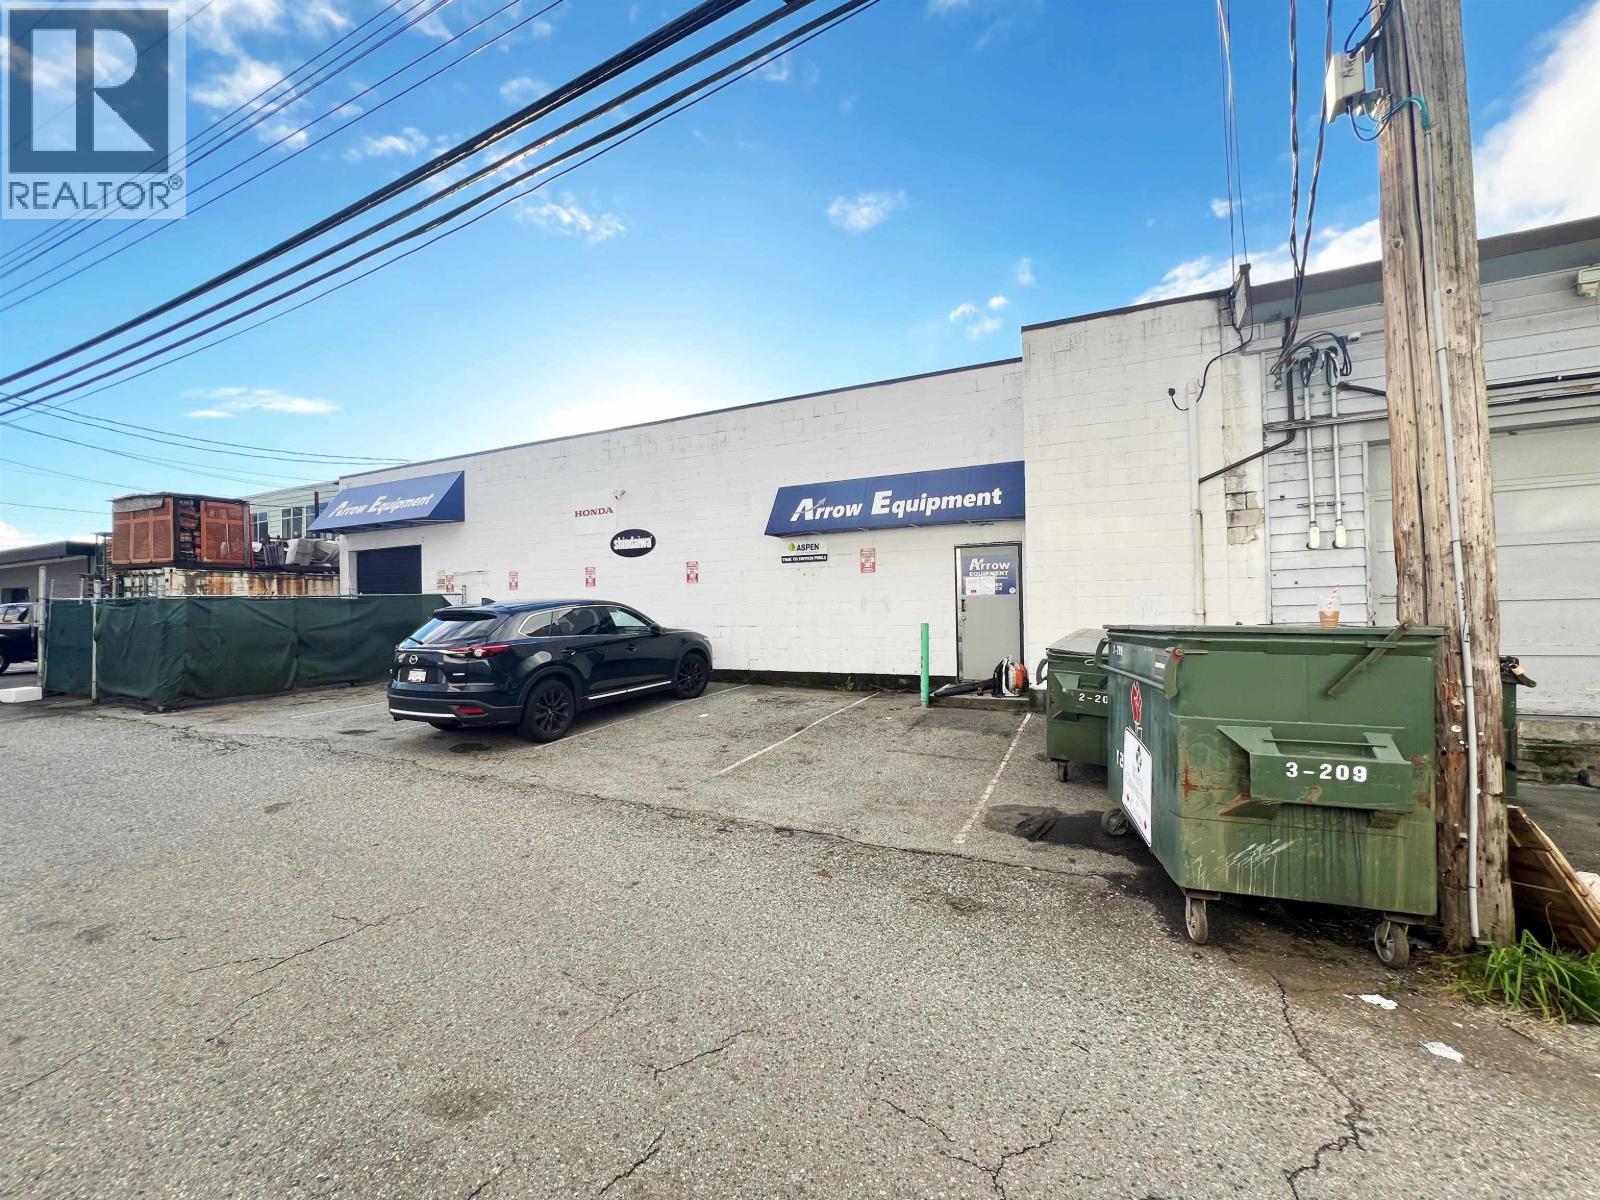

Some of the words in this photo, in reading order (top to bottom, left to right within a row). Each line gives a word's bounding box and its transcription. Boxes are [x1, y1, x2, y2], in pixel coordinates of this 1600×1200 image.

[328, 500, 369, 518] Arrow
[367, 493, 434, 515] Equipment
[789, 497, 863, 521] Arrow
[870, 487, 1003, 519] Equipment
[574, 507, 614, 518] HONDA
[613, 535, 653, 550] shindaiwa
[796, 543, 820, 552] ASPEN
[969, 558, 1010, 571] Arrow
[1285, 761, 1368, 783] 3-209
